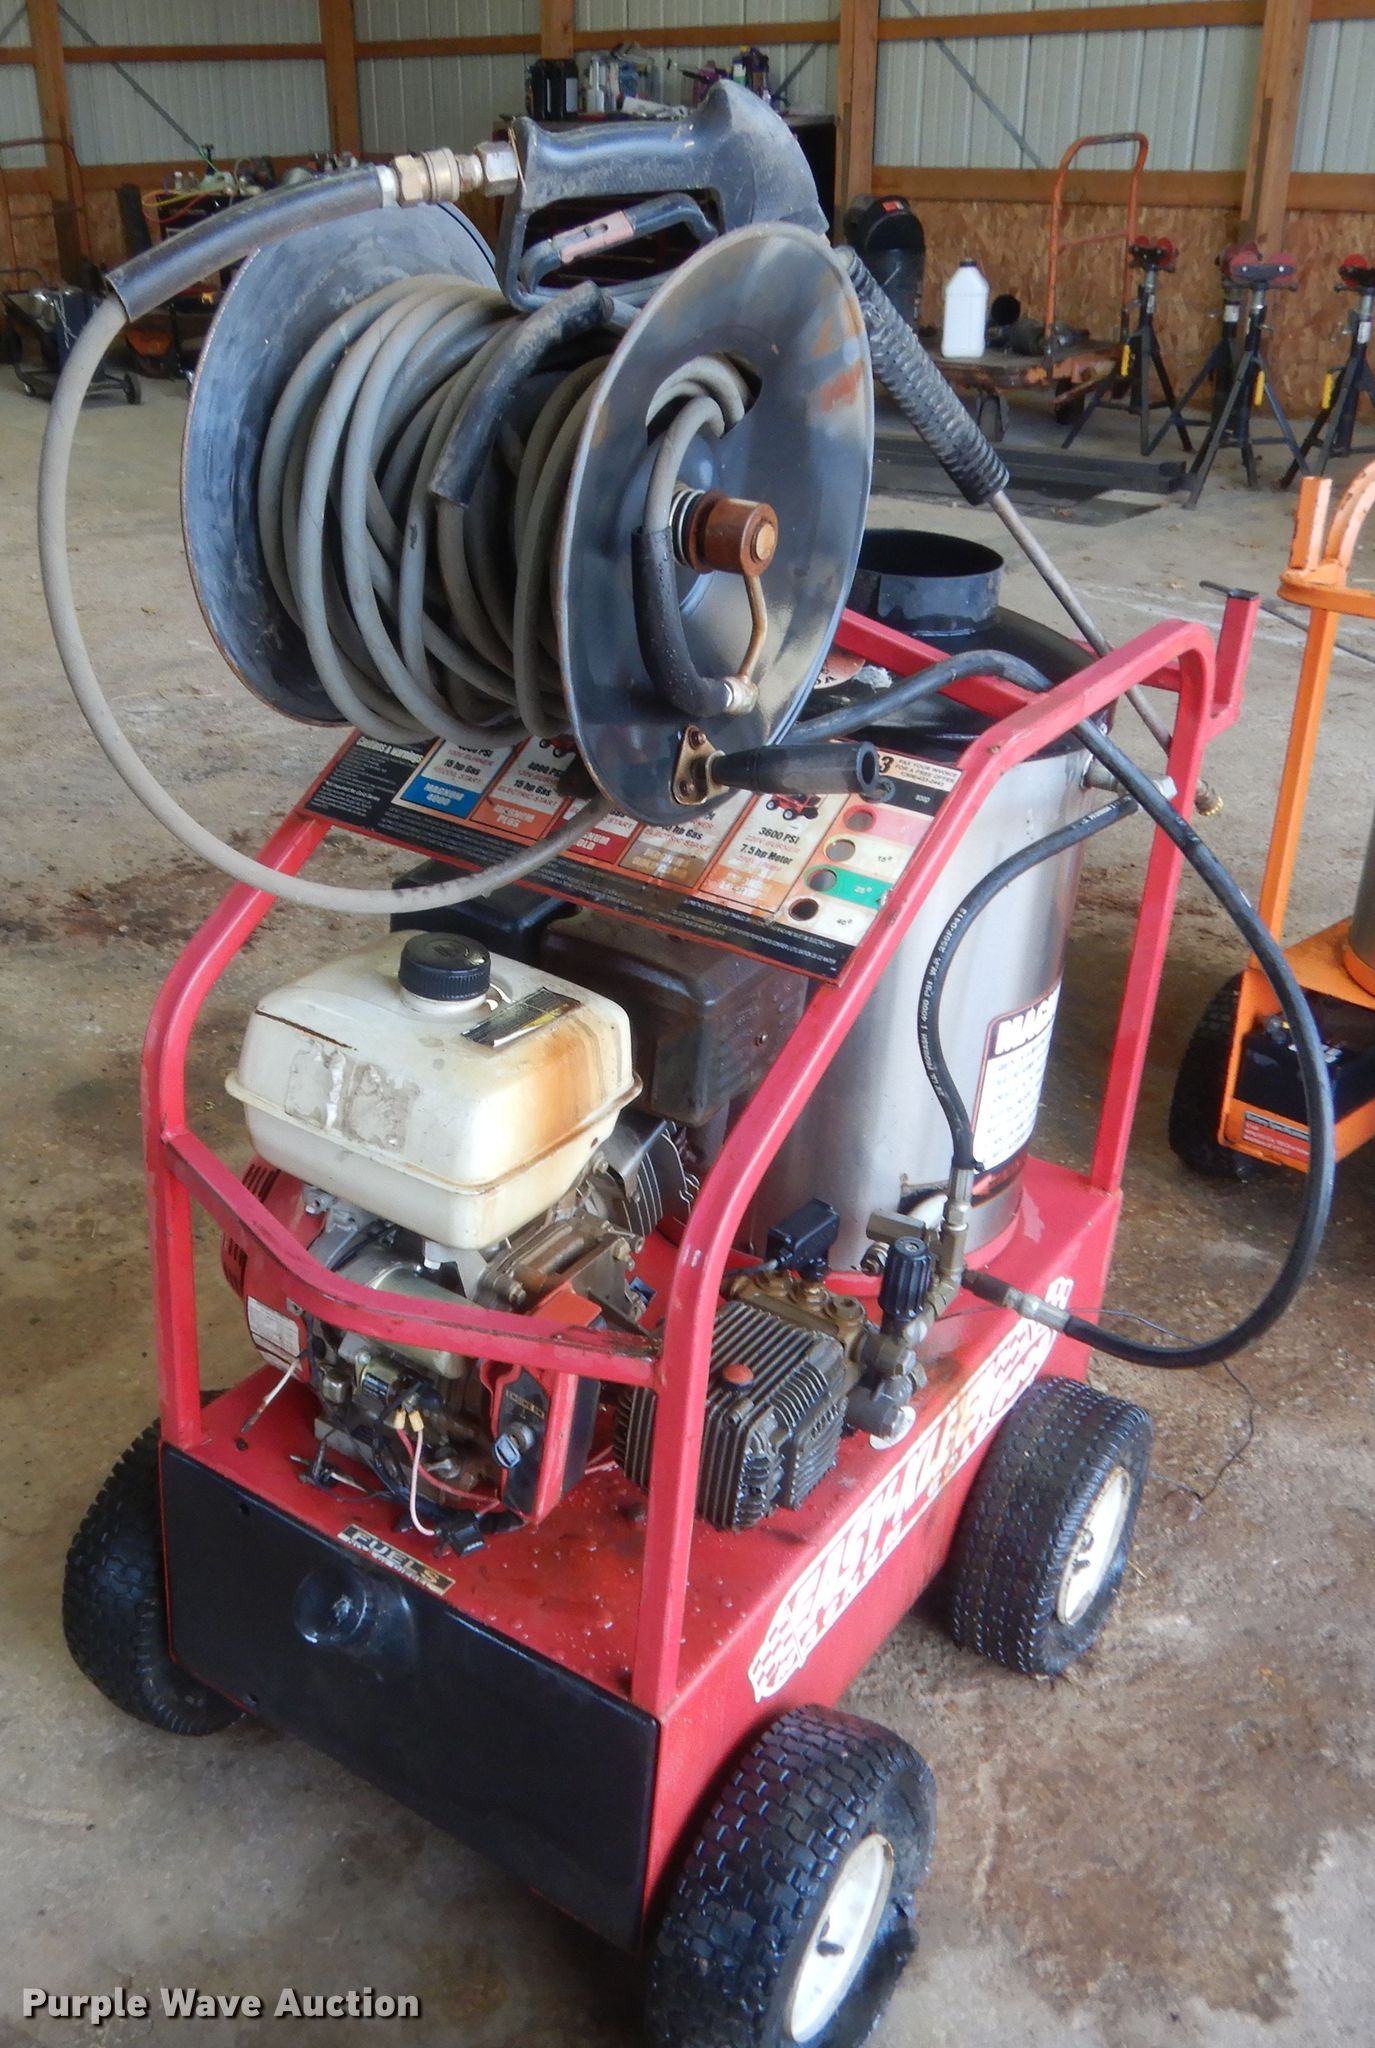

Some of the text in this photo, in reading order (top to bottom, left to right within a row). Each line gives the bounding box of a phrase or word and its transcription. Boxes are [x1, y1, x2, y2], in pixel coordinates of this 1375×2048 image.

[686, 829, 703, 840] Gas
[759, 827, 800, 845] 3600 PSI
[740, 844, 755, 855] 7.5
[754, 847, 767, 858] hp
[767, 852, 793, 866] Motor
[923, 980, 933, 998] PSI
[920, 1000, 931, 1022] 4000
[351, 1530, 440, 1584] FUELS
